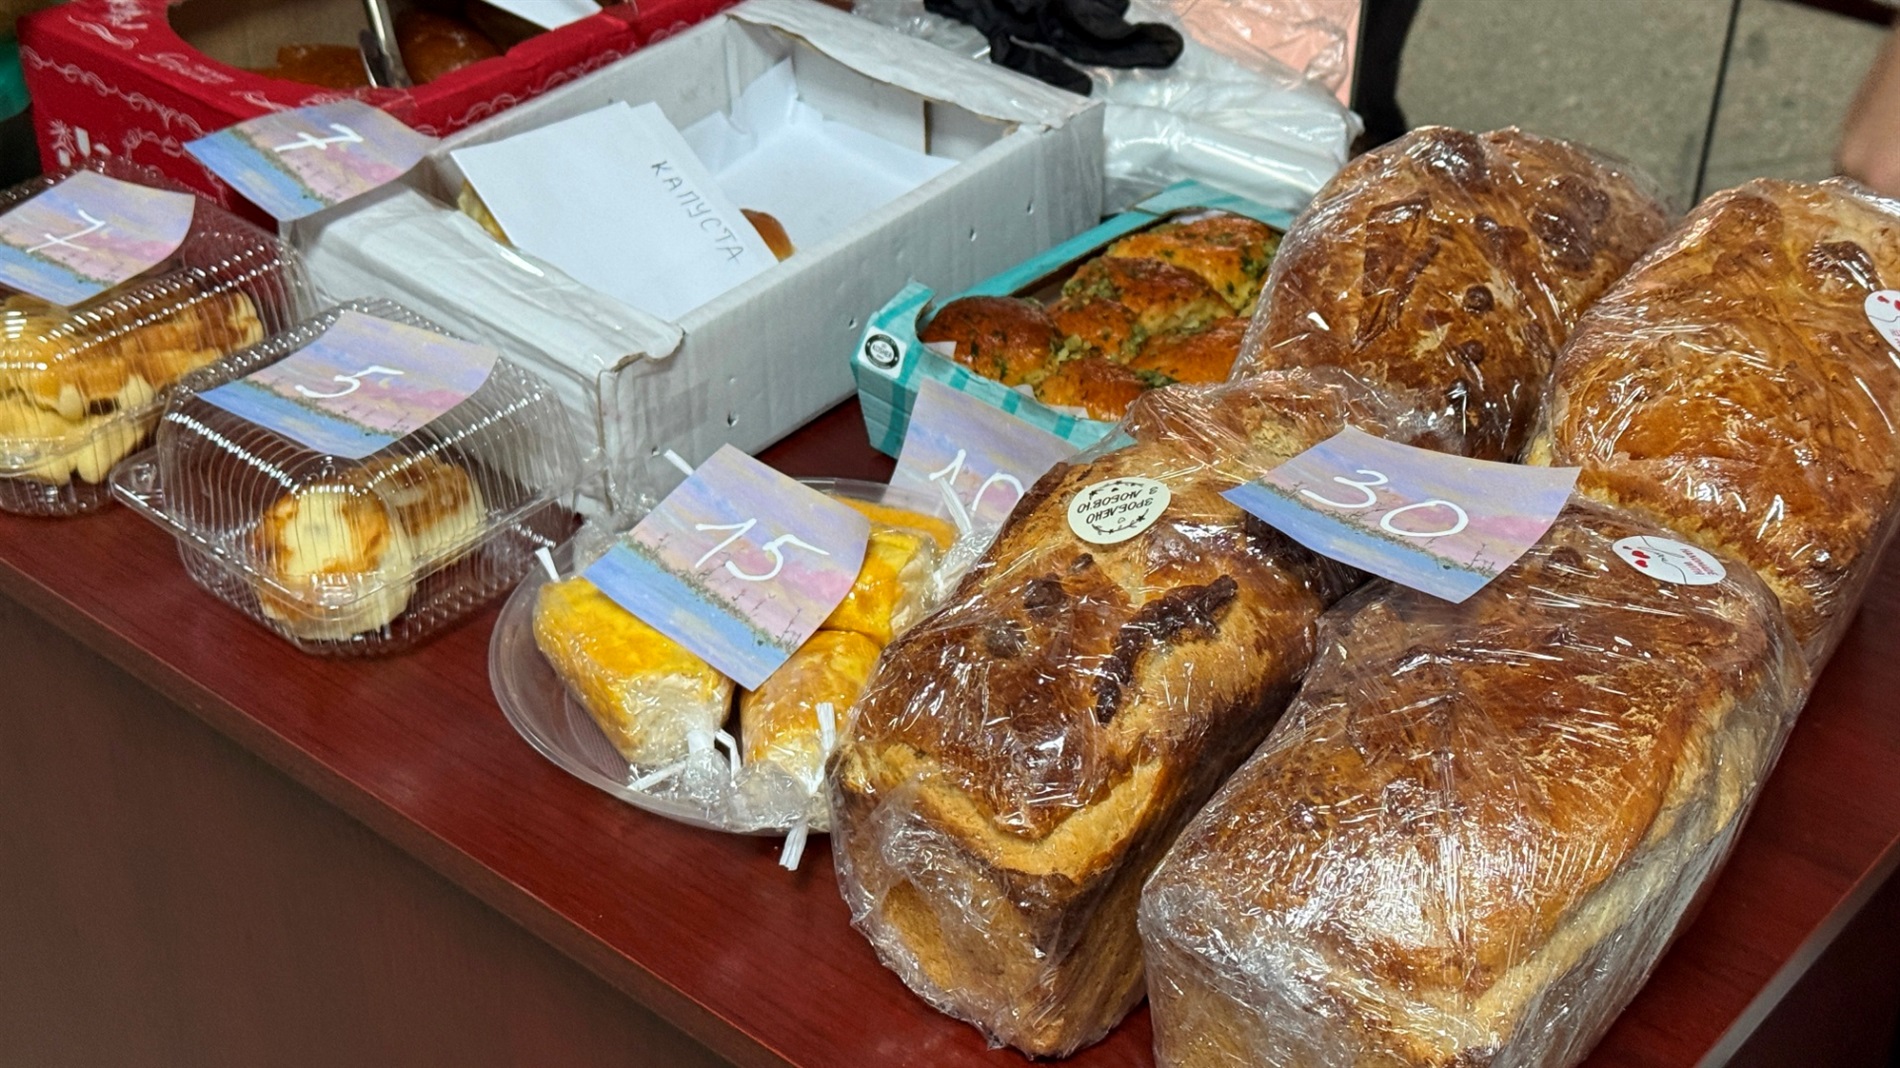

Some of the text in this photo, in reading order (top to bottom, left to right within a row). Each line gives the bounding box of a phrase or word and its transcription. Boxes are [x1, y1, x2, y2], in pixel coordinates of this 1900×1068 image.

[273, 123, 364, 153] 7
[26, 208, 106, 254] 7
[651, 160, 744, 264] КАПУСТА
[295, 364, 405, 398] 5
[1148, 486, 1159, 495] З
[1300, 469, 1469, 537] 30
[1086, 497, 1154, 525] ЗРОБЛЕНО
[695, 517, 831, 582] 15
